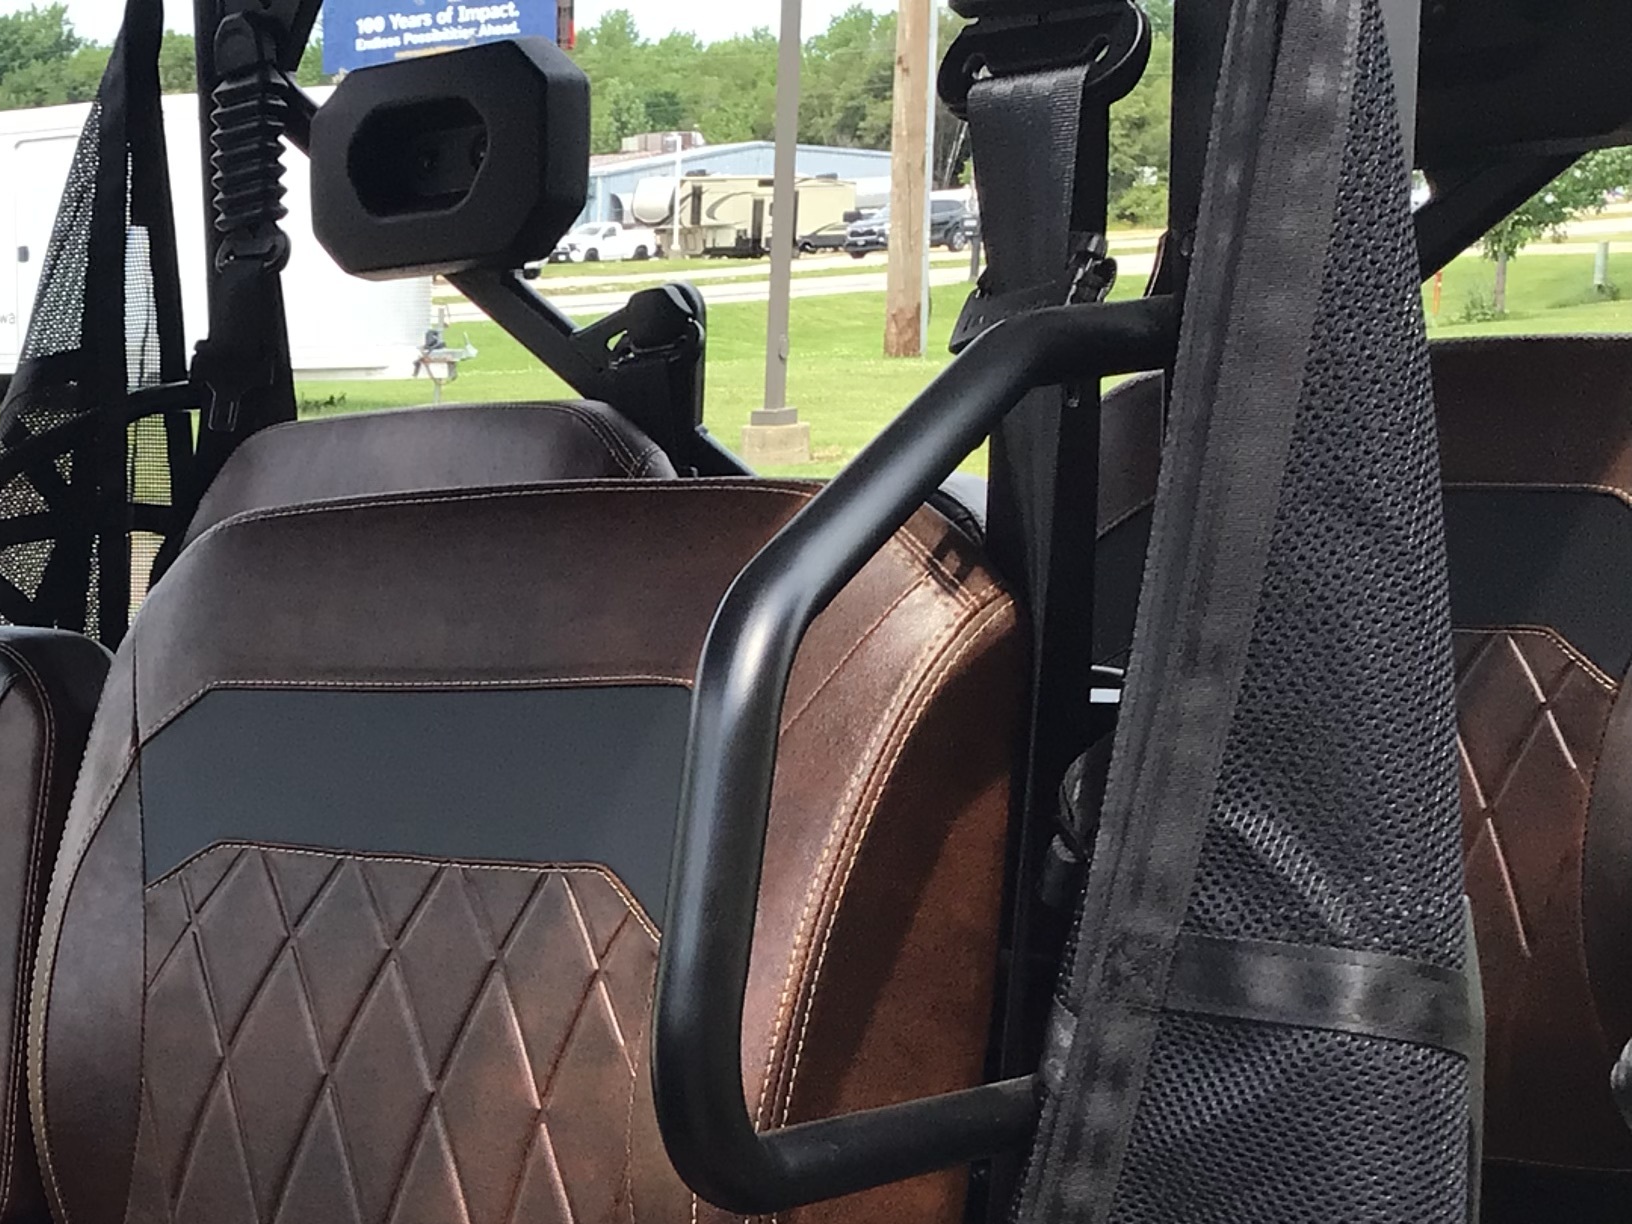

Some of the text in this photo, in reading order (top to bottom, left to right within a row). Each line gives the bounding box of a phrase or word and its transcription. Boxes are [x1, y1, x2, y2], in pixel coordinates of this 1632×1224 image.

[355, 1, 520, 35] 100 Years of Impact.
